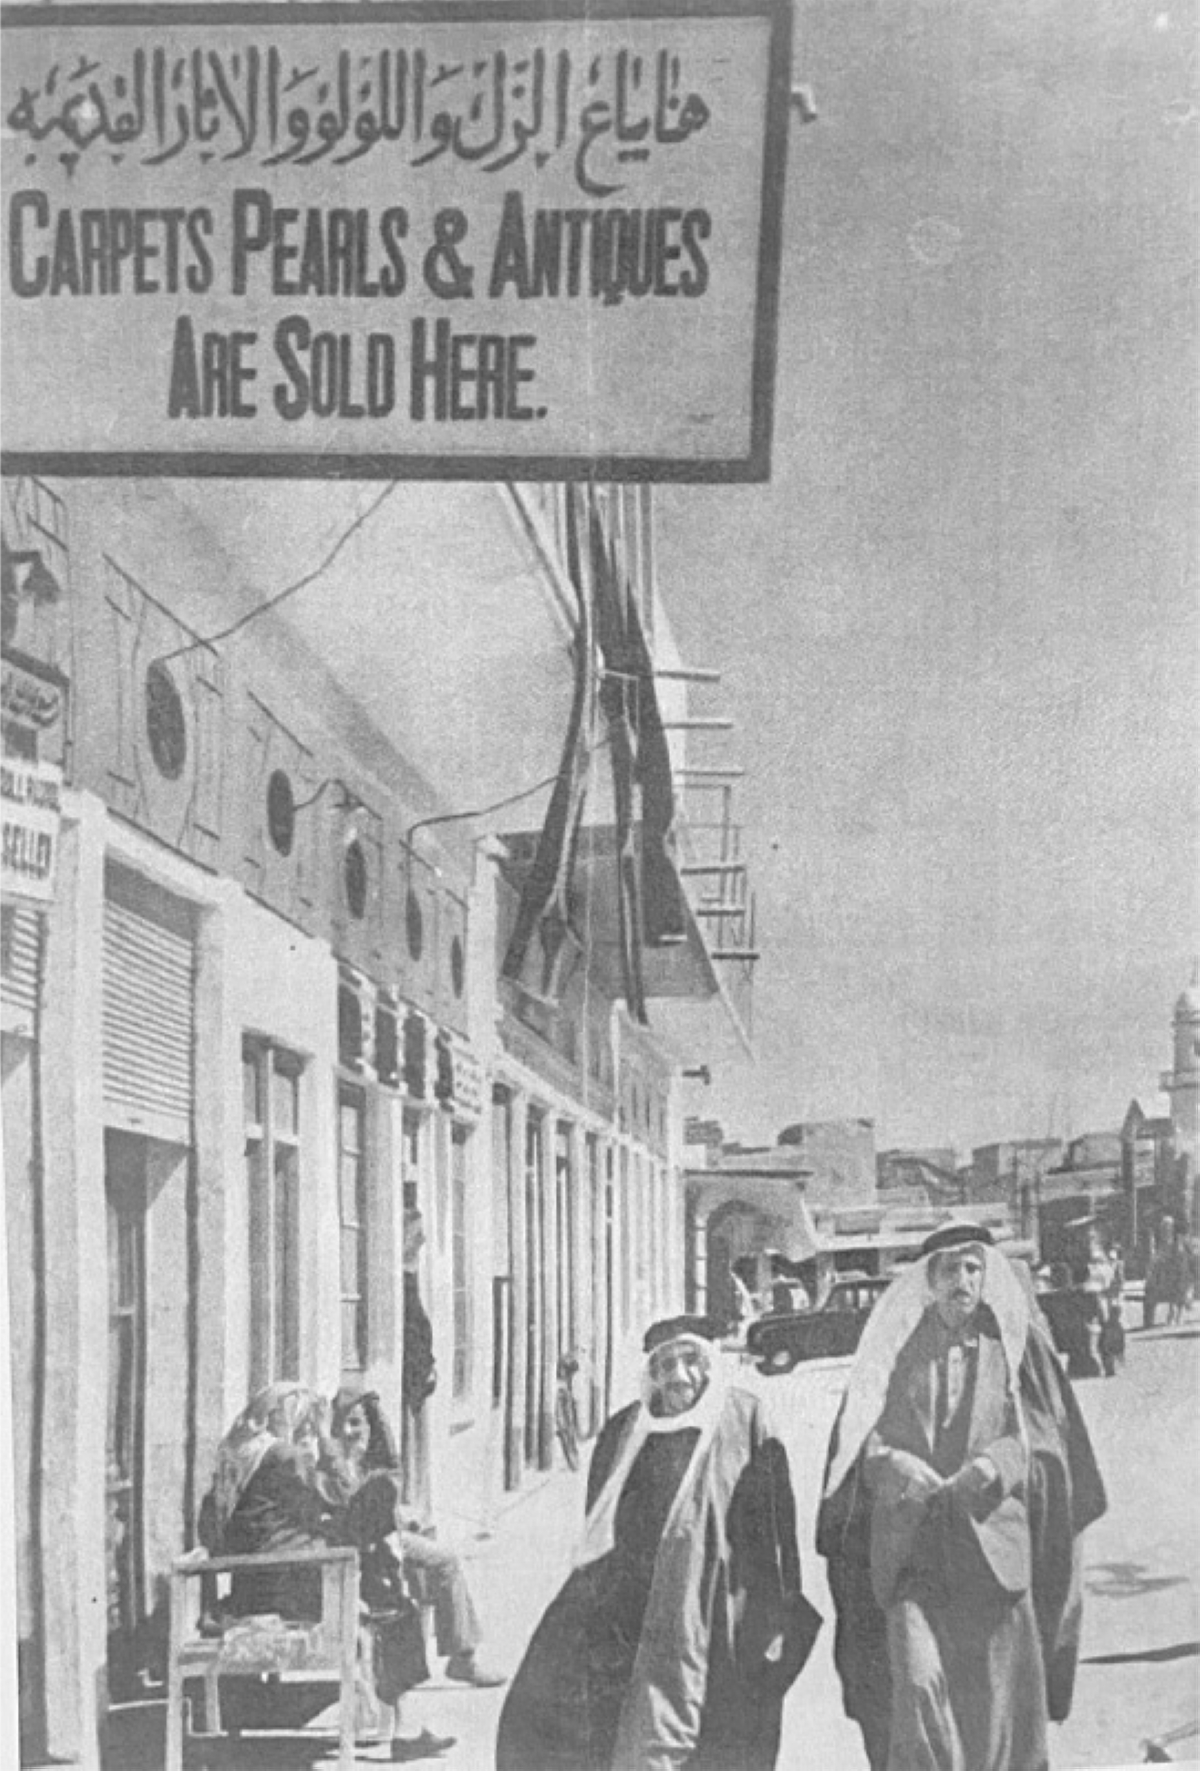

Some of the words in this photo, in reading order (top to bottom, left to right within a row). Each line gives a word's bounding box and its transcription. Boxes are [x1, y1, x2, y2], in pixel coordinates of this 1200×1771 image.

[575, 49, 650, 198] يباع
[655, 49, 710, 144] هنا
[9, 189, 214, 298] CARPETS
[231, 188, 409, 298] PEARLS
[422, 208, 474, 300] &
[488, 189, 712, 307] ANTIQUES
[168, 315, 258, 420] ARE
[273, 315, 396, 421] SOLD
[409, 316, 547, 421] HERE.
